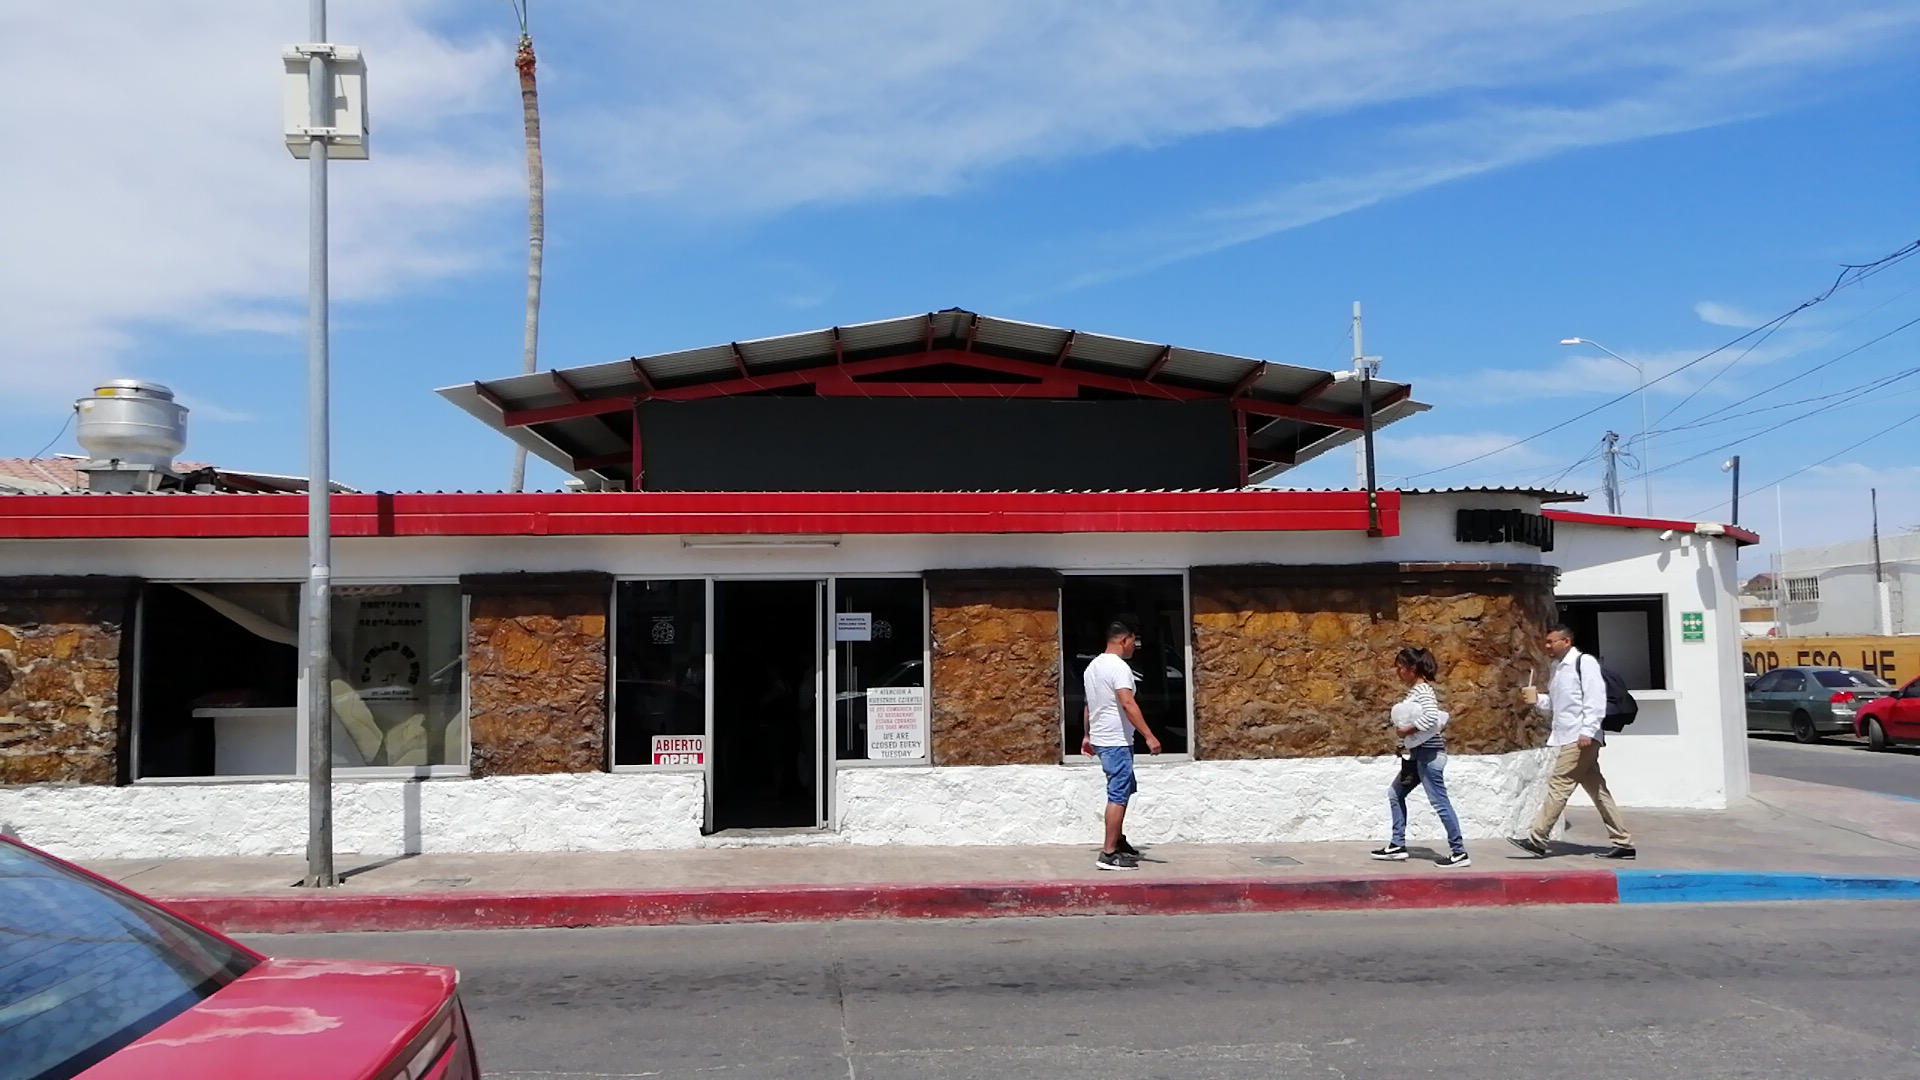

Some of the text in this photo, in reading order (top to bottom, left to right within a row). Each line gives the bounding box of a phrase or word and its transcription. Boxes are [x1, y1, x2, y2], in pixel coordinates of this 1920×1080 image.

[1862, 651, 1896, 685] HE
[883, 732, 910, 740] WE ARE
[656, 739, 703, 751] ABIERTO
[871, 741, 921, 749] CLOSED EVERY
[881, 750, 912, 758] TUESDAY
[659, 754, 698, 765] OPEN
